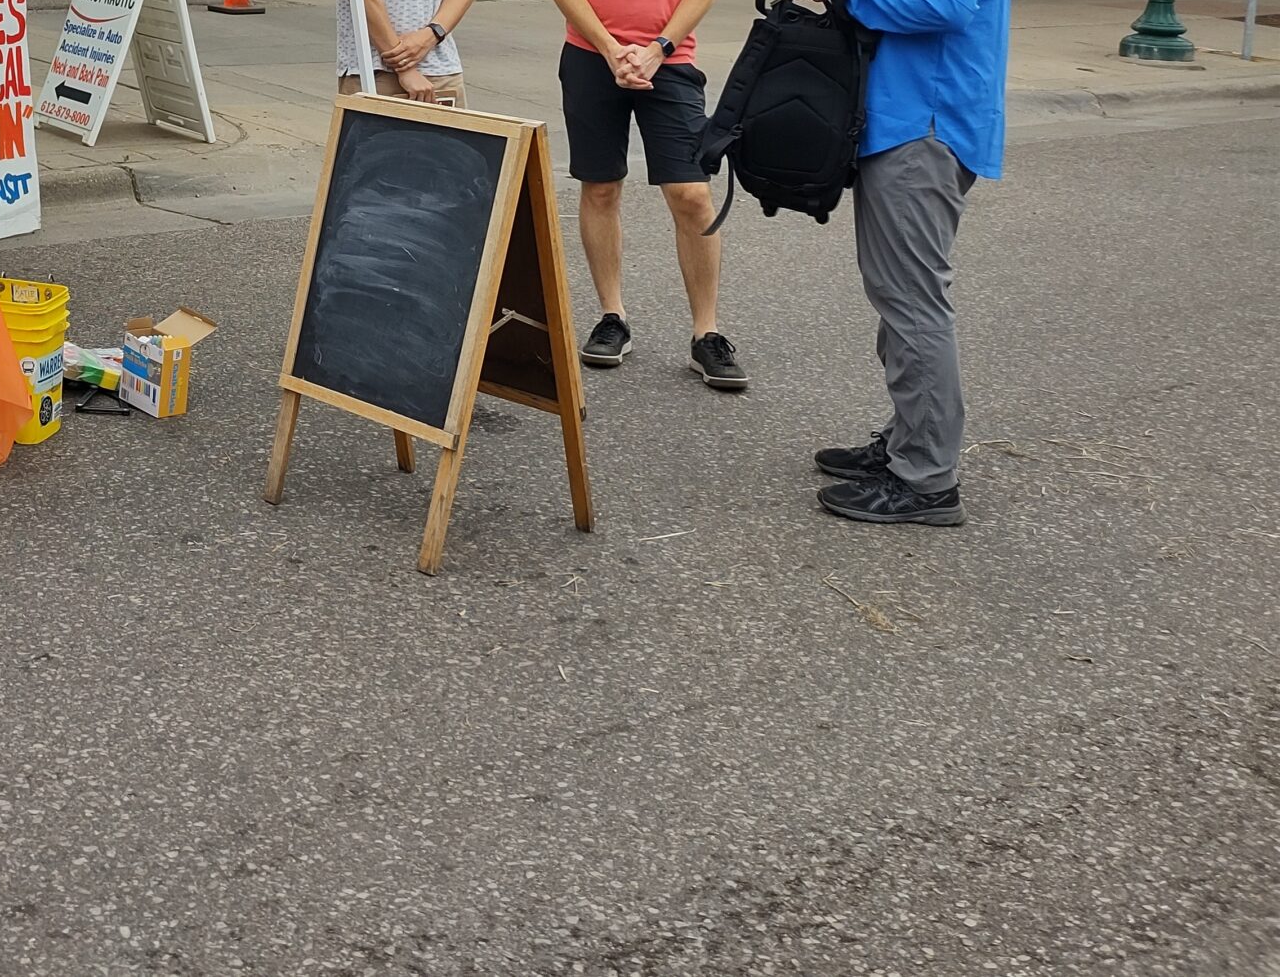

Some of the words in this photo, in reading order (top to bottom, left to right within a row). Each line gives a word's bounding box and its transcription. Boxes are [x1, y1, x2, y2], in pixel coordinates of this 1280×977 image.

[63, 18, 97, 39] Specialize
[98, 26, 105, 40] in
[105, 28, 123, 45] Auto
[59, 38, 89, 59] Accident
[89, 45, 115, 65] Injuries
[50, 56, 66, 74] Neck
[66, 63, 78, 79] and
[78, 65, 94, 84] Back
[93, 68, 110, 88] Pain
[40, 100, 90, 127] 612-879-8000
